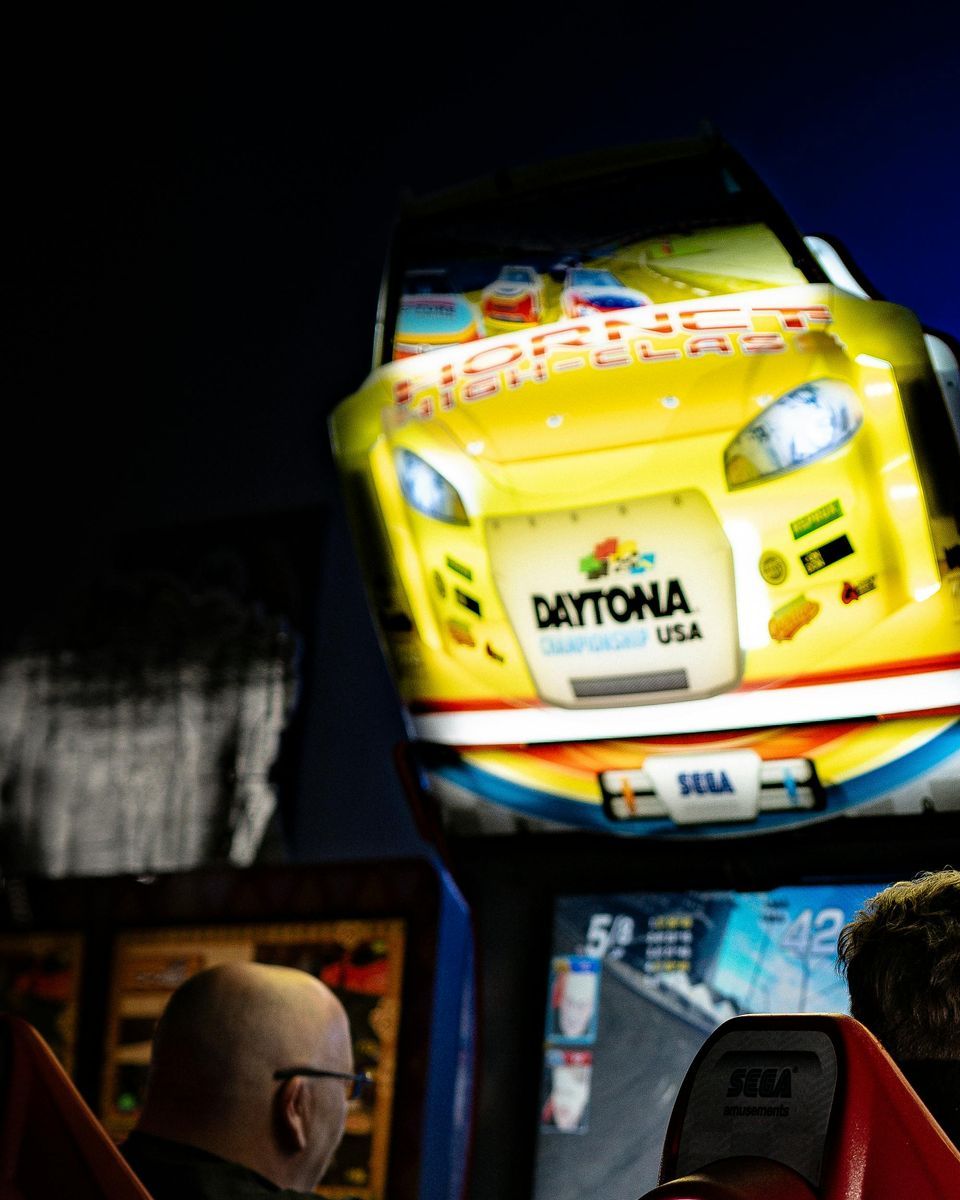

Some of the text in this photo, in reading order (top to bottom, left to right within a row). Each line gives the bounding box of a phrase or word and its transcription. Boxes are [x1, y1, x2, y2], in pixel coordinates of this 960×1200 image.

[531, 577, 692, 629] DAYTONA
[656, 622, 703, 644] USA
[781, 907, 845, 953] 42
[726, 1067, 793, 1099] SEGA
[723, 1103, 790, 1118] amusements
